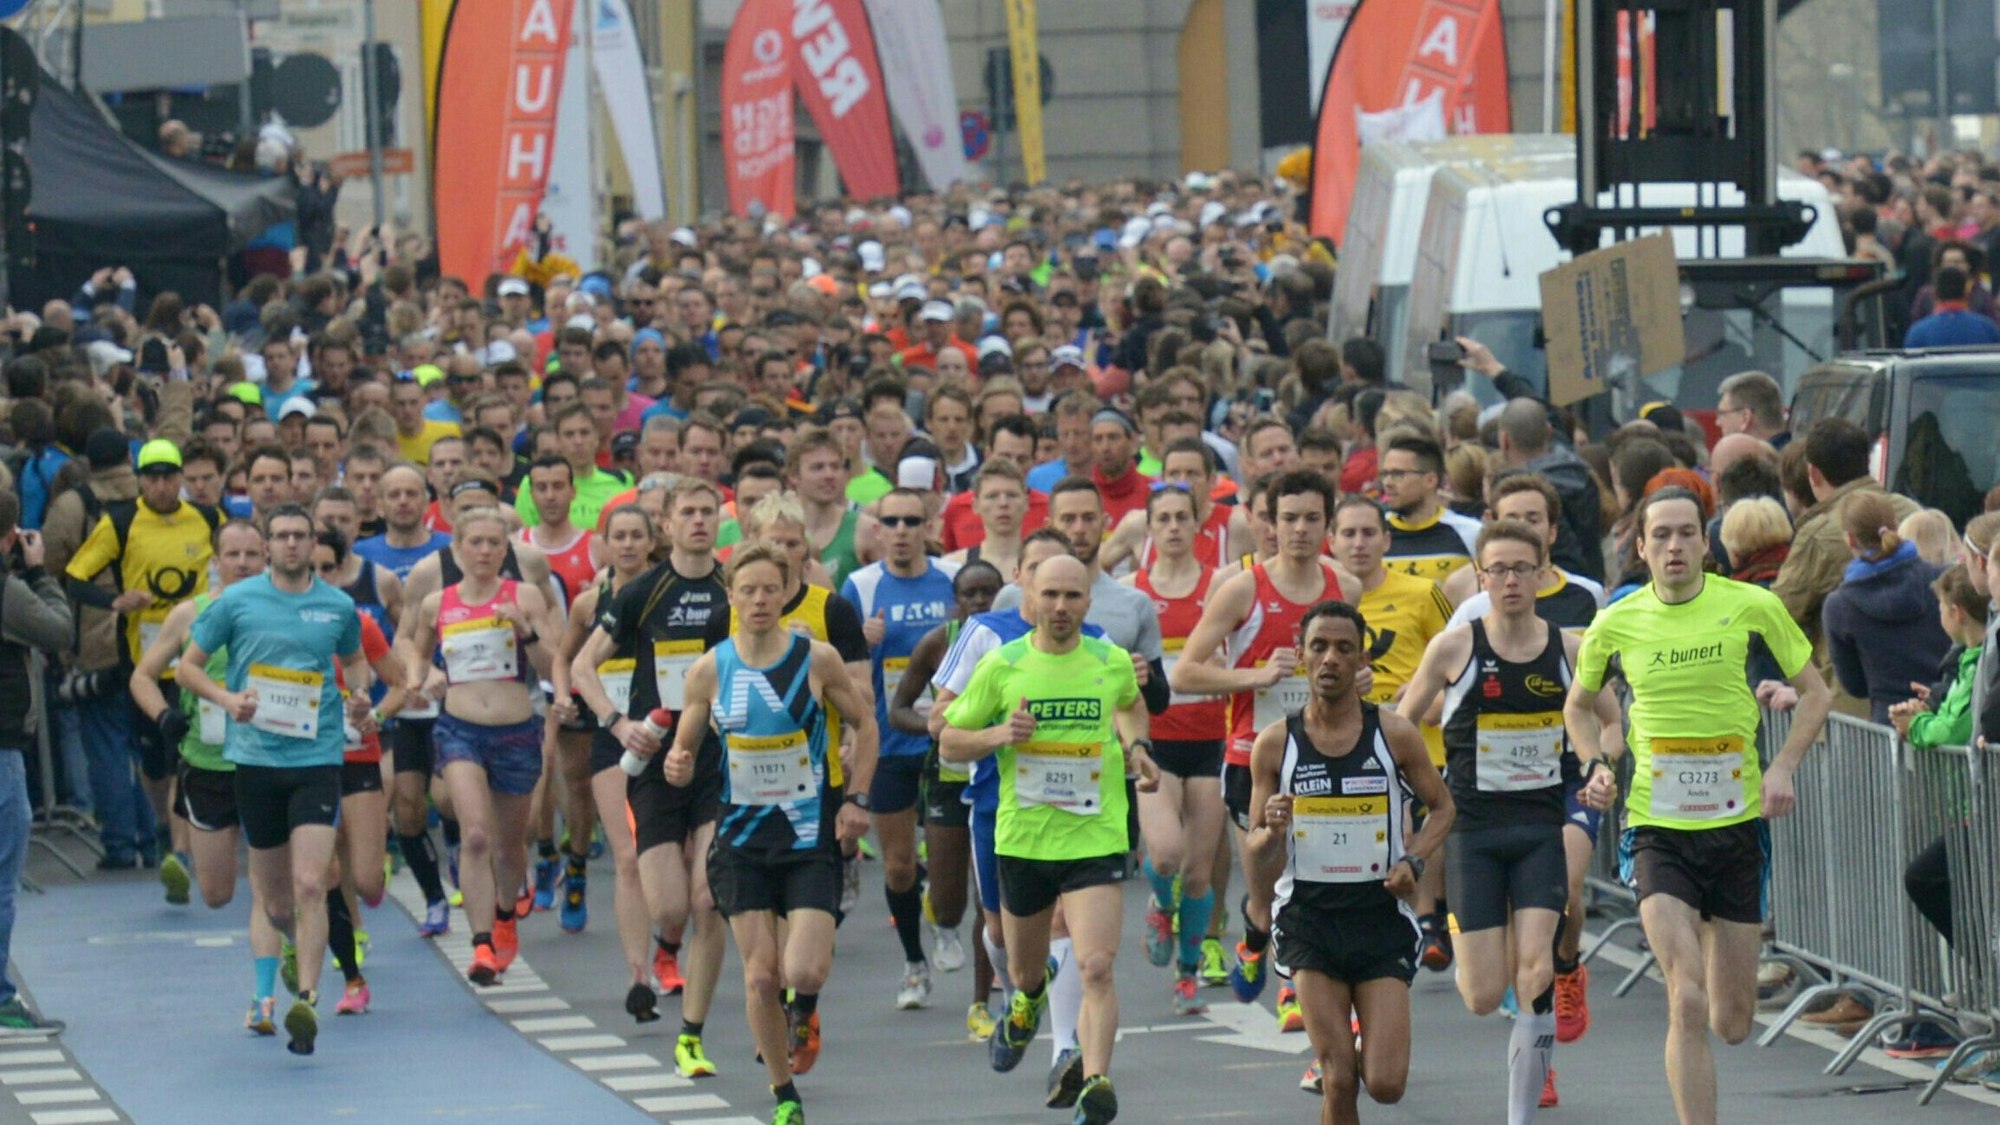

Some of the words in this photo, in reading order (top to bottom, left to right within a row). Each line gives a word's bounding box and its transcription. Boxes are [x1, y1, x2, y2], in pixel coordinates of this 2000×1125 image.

[1669, 641, 1723, 664] bunert
[1030, 701, 1100, 718] PETERS
[1510, 745, 1539, 757] 4795
[753, 763, 786, 775] 11871
[1045, 772, 1074, 784] 8291
[1679, 771, 1719, 784] C3273
[1332, 832, 1347, 845] 21
